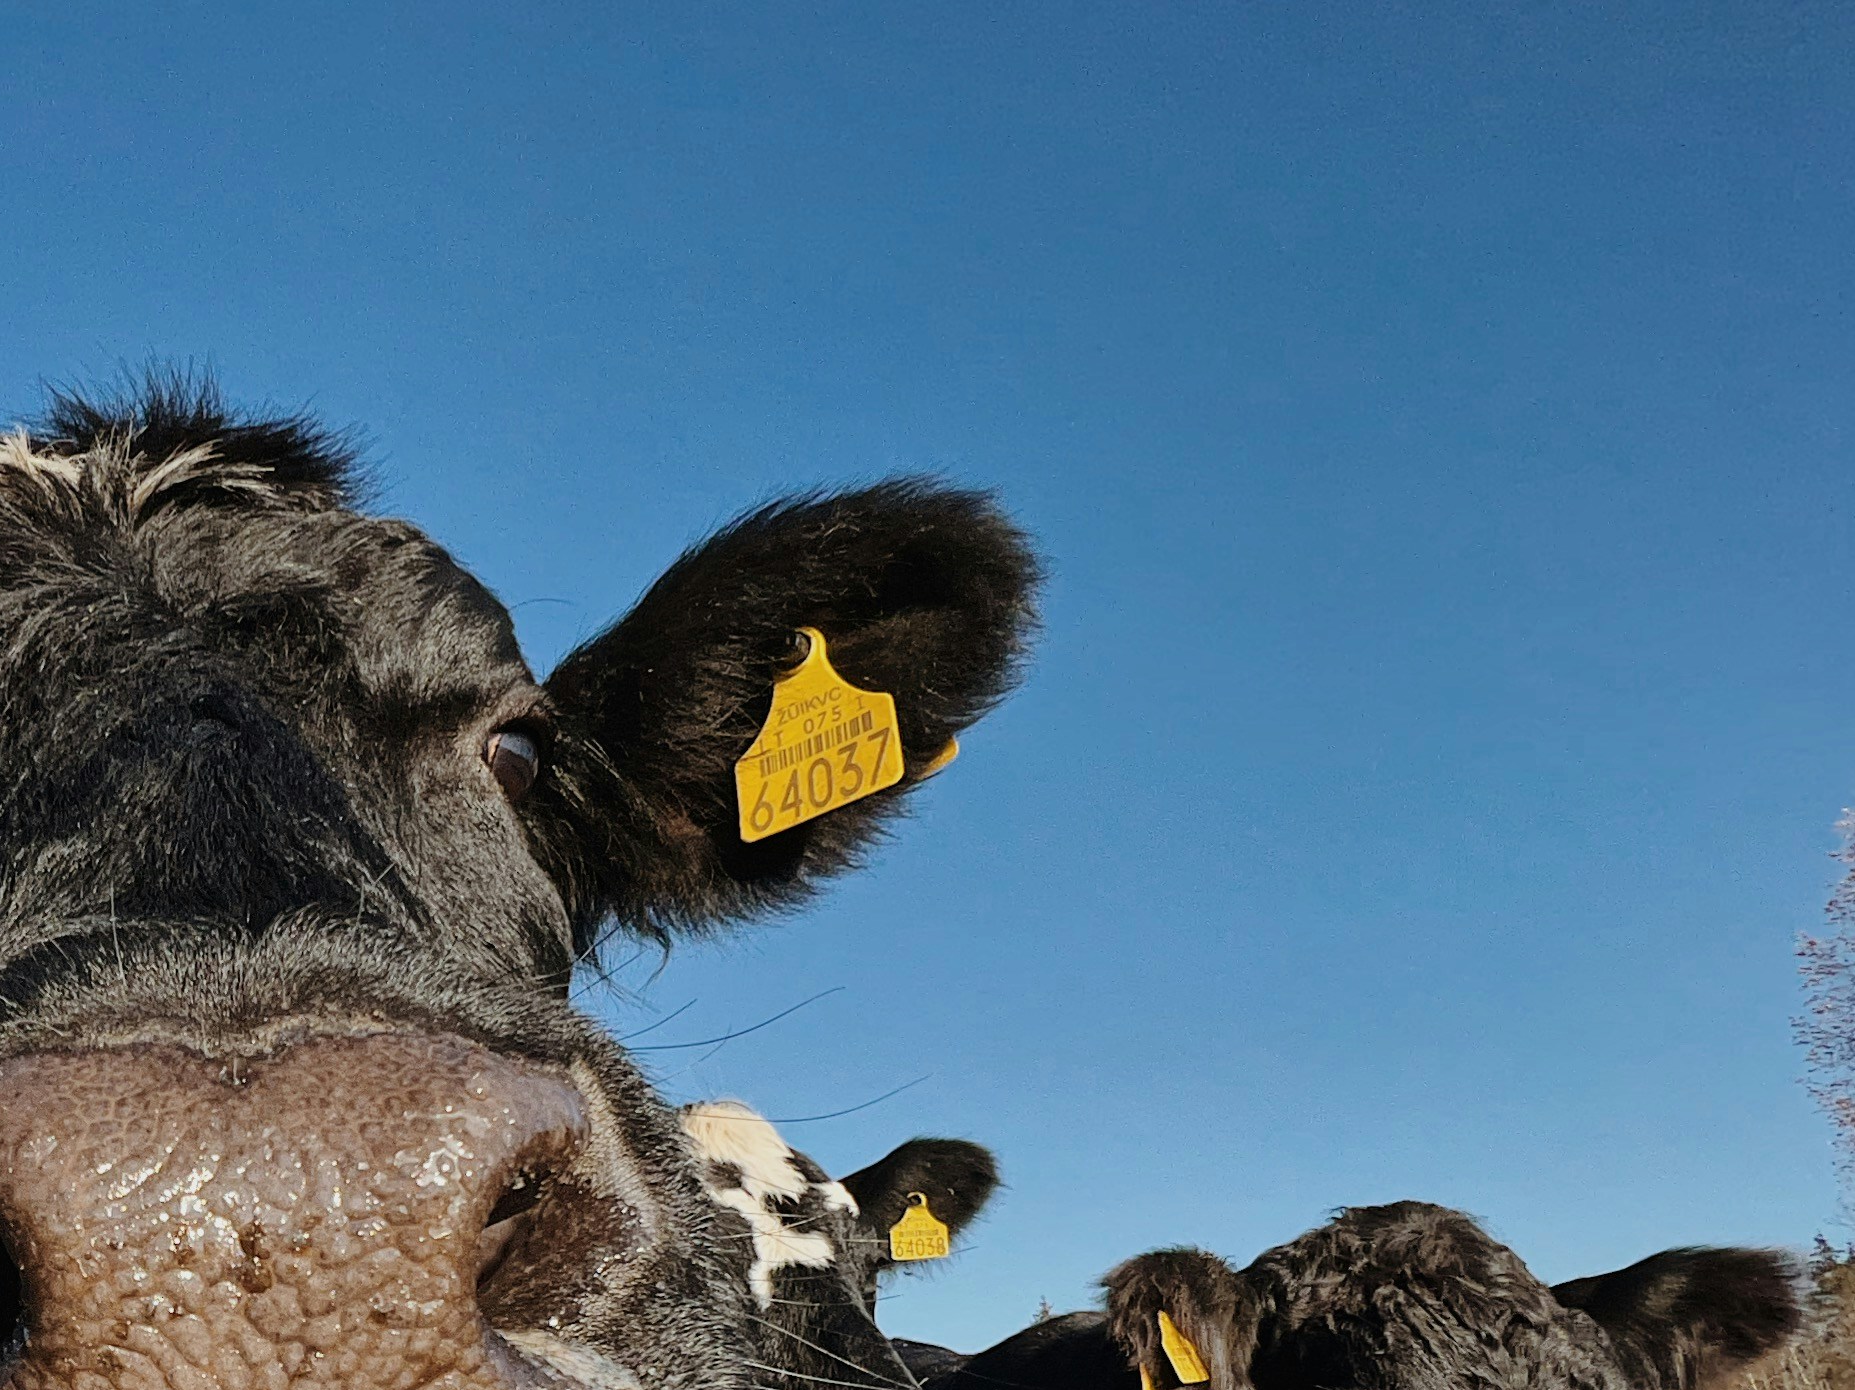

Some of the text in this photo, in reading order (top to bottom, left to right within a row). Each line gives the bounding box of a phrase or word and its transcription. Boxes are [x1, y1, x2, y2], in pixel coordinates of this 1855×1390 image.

[803, 705, 842, 734] 075
[749, 726, 891, 832] 64037
[895, 1237, 946, 1258] 64038
